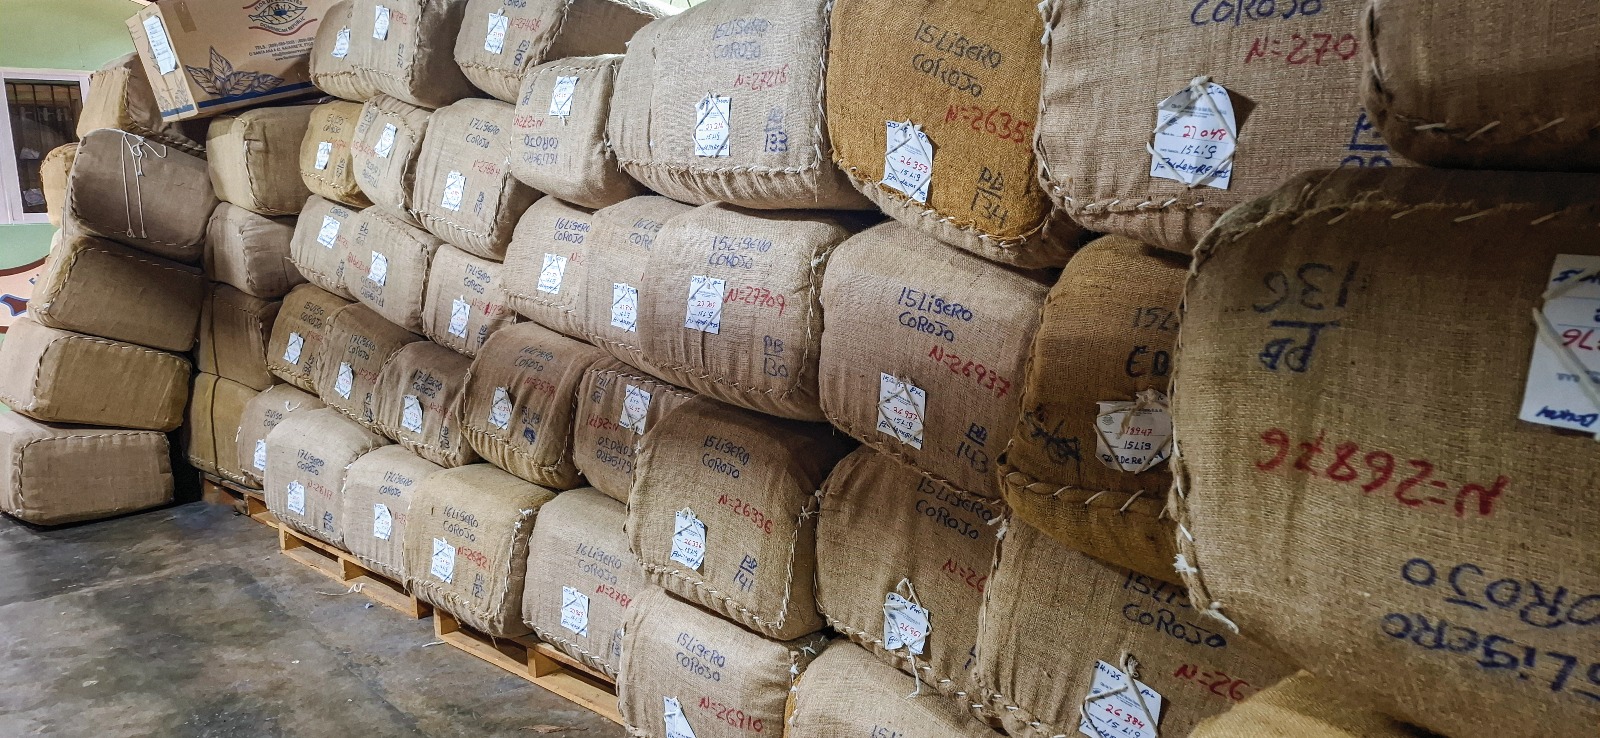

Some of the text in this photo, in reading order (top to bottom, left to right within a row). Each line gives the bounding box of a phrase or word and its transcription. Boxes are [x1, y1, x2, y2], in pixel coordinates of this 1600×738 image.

[1190, 0, 1322, 26] COROJO
[1245, 34, 1359, 66] N=270
[912, 54, 982, 97] COROJO
[945, 105, 1034, 143] N=2635
[466, 134, 489, 148] COROJO
[764, 131, 788, 153] 133
[554, 230, 584, 244] COROJO
[464, 277, 484, 294] COROJO
[899, 311, 955, 342] COROJO
[763, 335, 784, 353] PB
[1562, 329, 1600, 351] 76
[515, 356, 544, 372] COROJO
[929, 345, 1012, 398] N=26937
[413, 382, 435, 398] COROJO
[598, 437, 634, 457] COROJO
[957, 442, 989, 473] 143
[297, 461, 319, 476] COROJO
[702, 453, 740, 479] COROJO
[1257, 428, 1510, 517] N=26876
[717, 494, 775, 535] N=26336
[916, 500, 979, 540] COROJO
[443, 520, 476, 542] COROJO
[577, 560, 617, 585] COROJO
[734, 570, 754, 593] 141
[1122, 603, 1227, 648] COROJO
[676, 651, 721, 682] COROJO
[1174, 663, 1263, 701] N=26
[699, 696, 763, 733] N=26910
